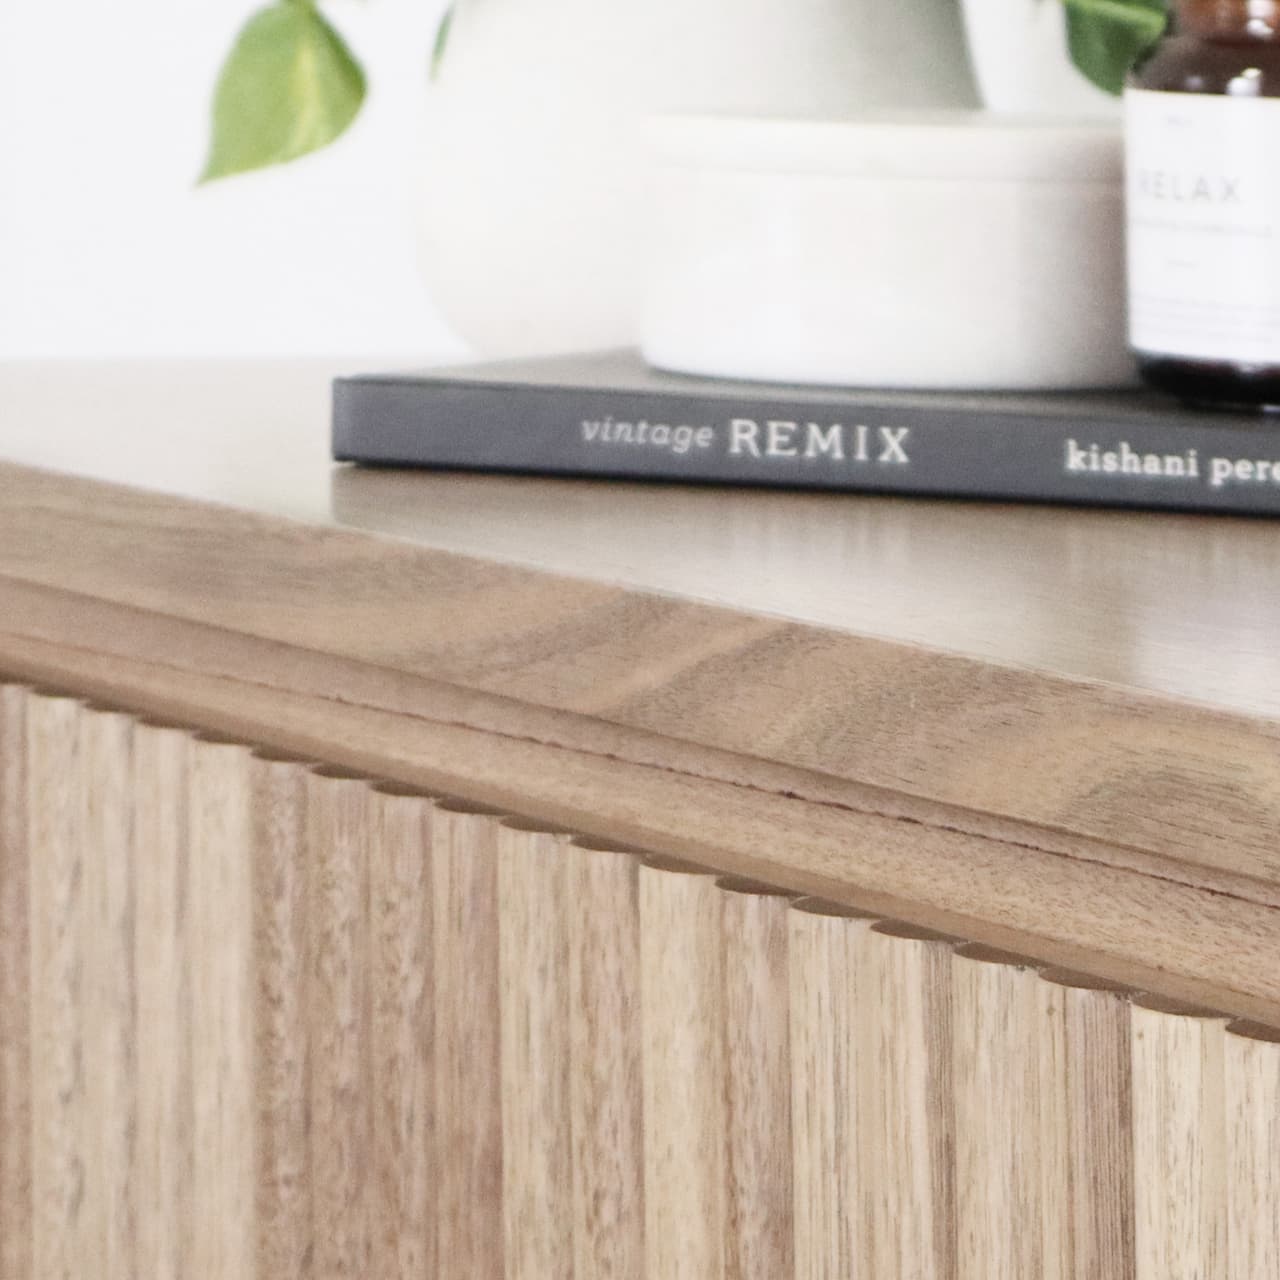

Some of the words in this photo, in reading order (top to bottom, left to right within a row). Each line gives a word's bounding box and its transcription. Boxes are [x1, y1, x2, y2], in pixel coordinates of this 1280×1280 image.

[581, 415, 714, 453] vintage
[728, 418, 910, 464] REMIX
[1065, 438, 1199, 478] kishani
